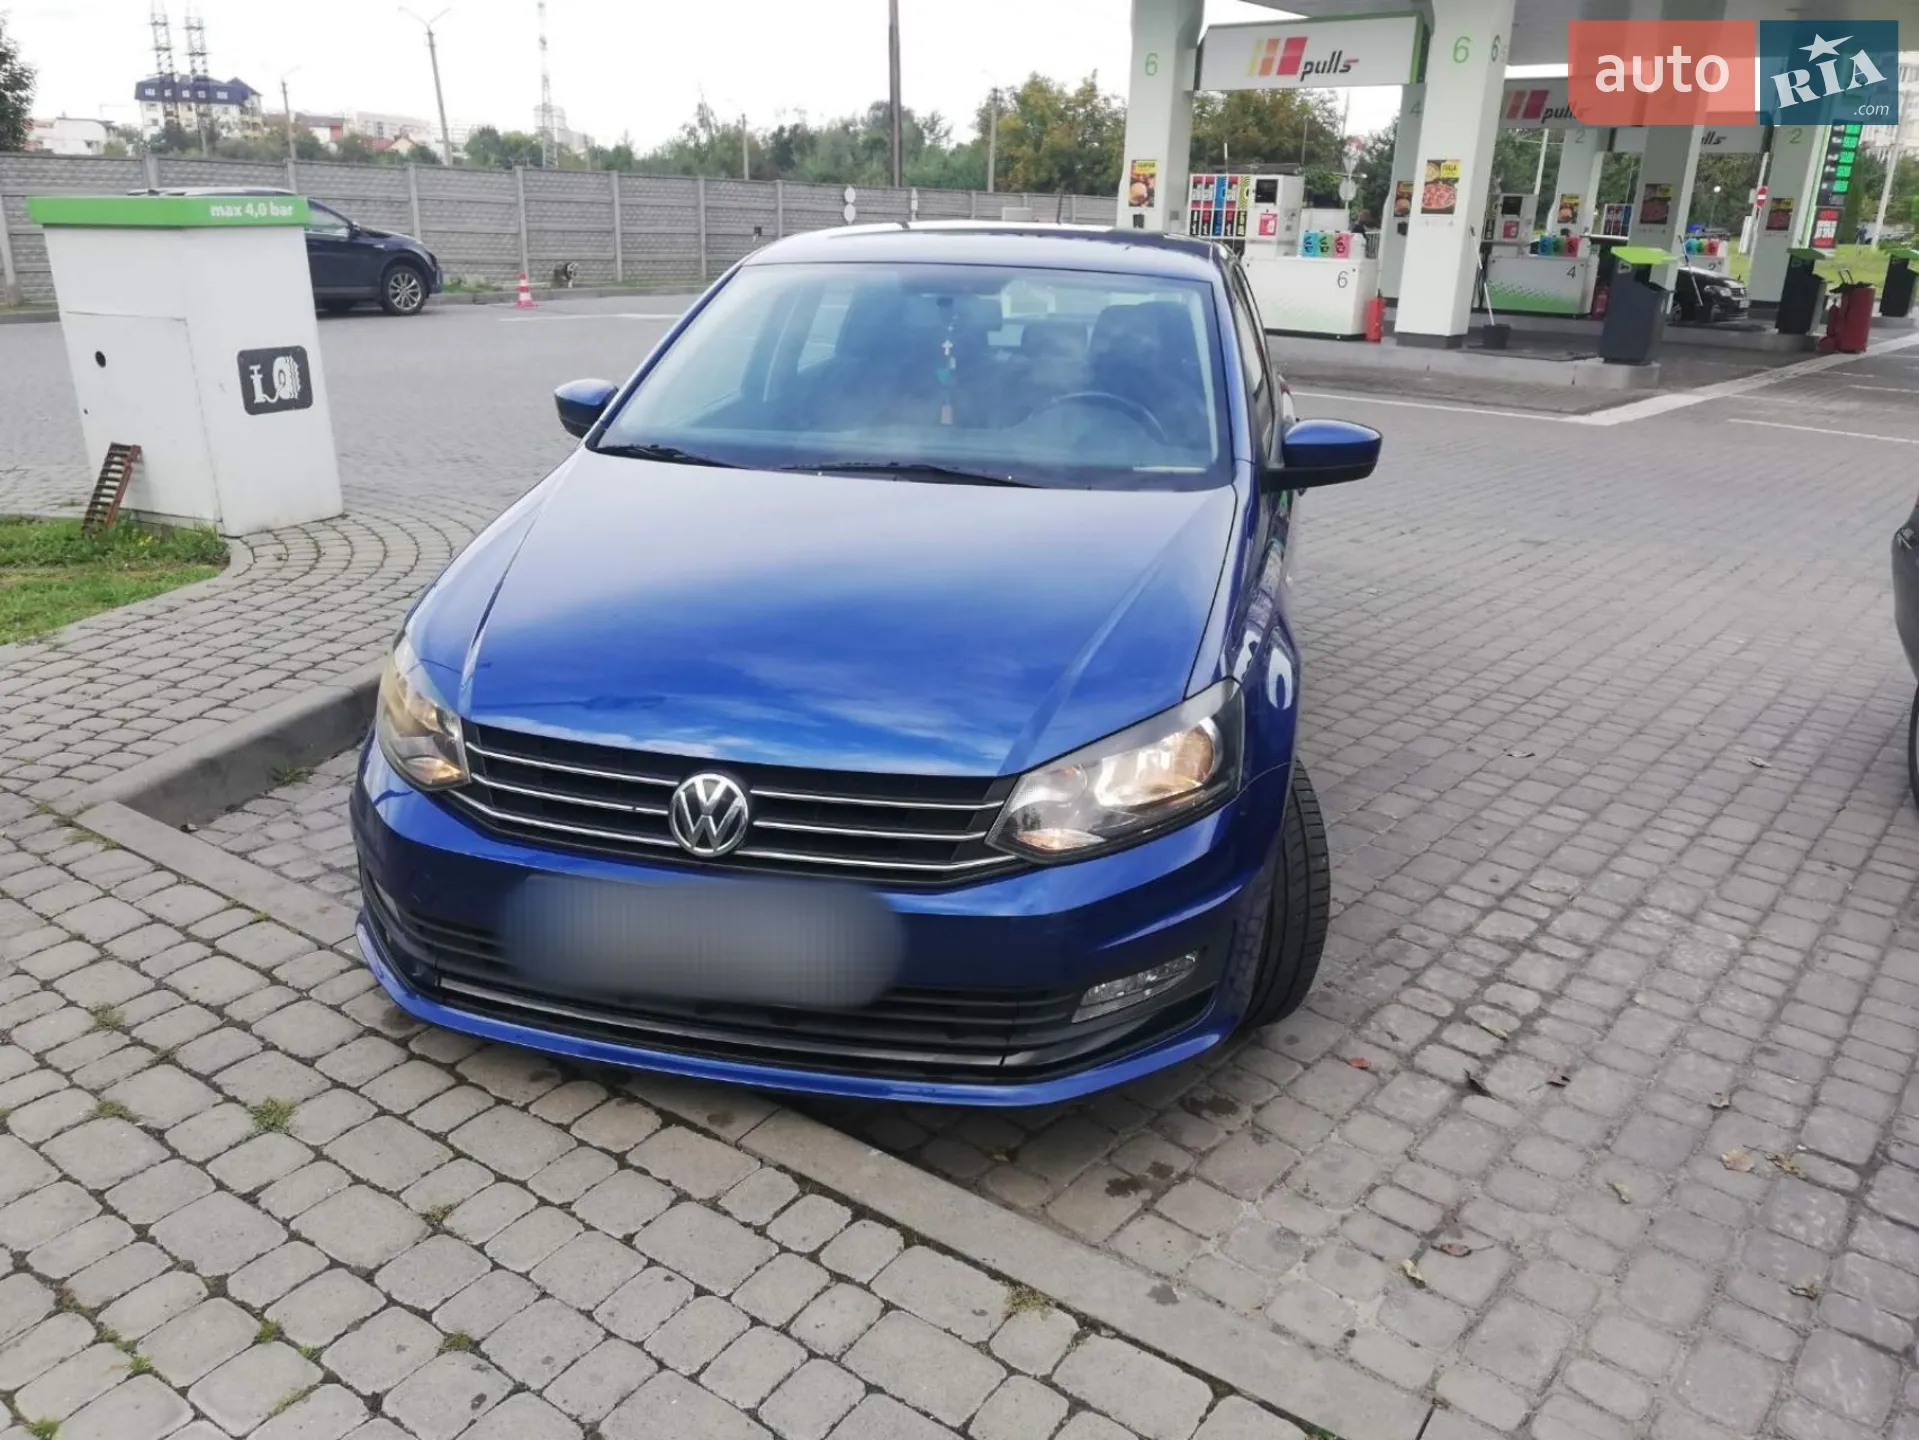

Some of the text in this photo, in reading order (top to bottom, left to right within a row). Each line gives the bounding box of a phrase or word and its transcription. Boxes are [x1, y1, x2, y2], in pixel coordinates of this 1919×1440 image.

[1453, 36, 1471, 64] 6
[1490, 34, 1501, 62] 6
[1144, 52, 1159, 76] 6
[1300, 50, 1359, 82] pulls
[1789, 127, 1803, 144] 2
[210, 201, 294, 218] max 4,0 bar
[1337, 270, 1349, 289] 6
[1566, 264, 1576, 279] 4
